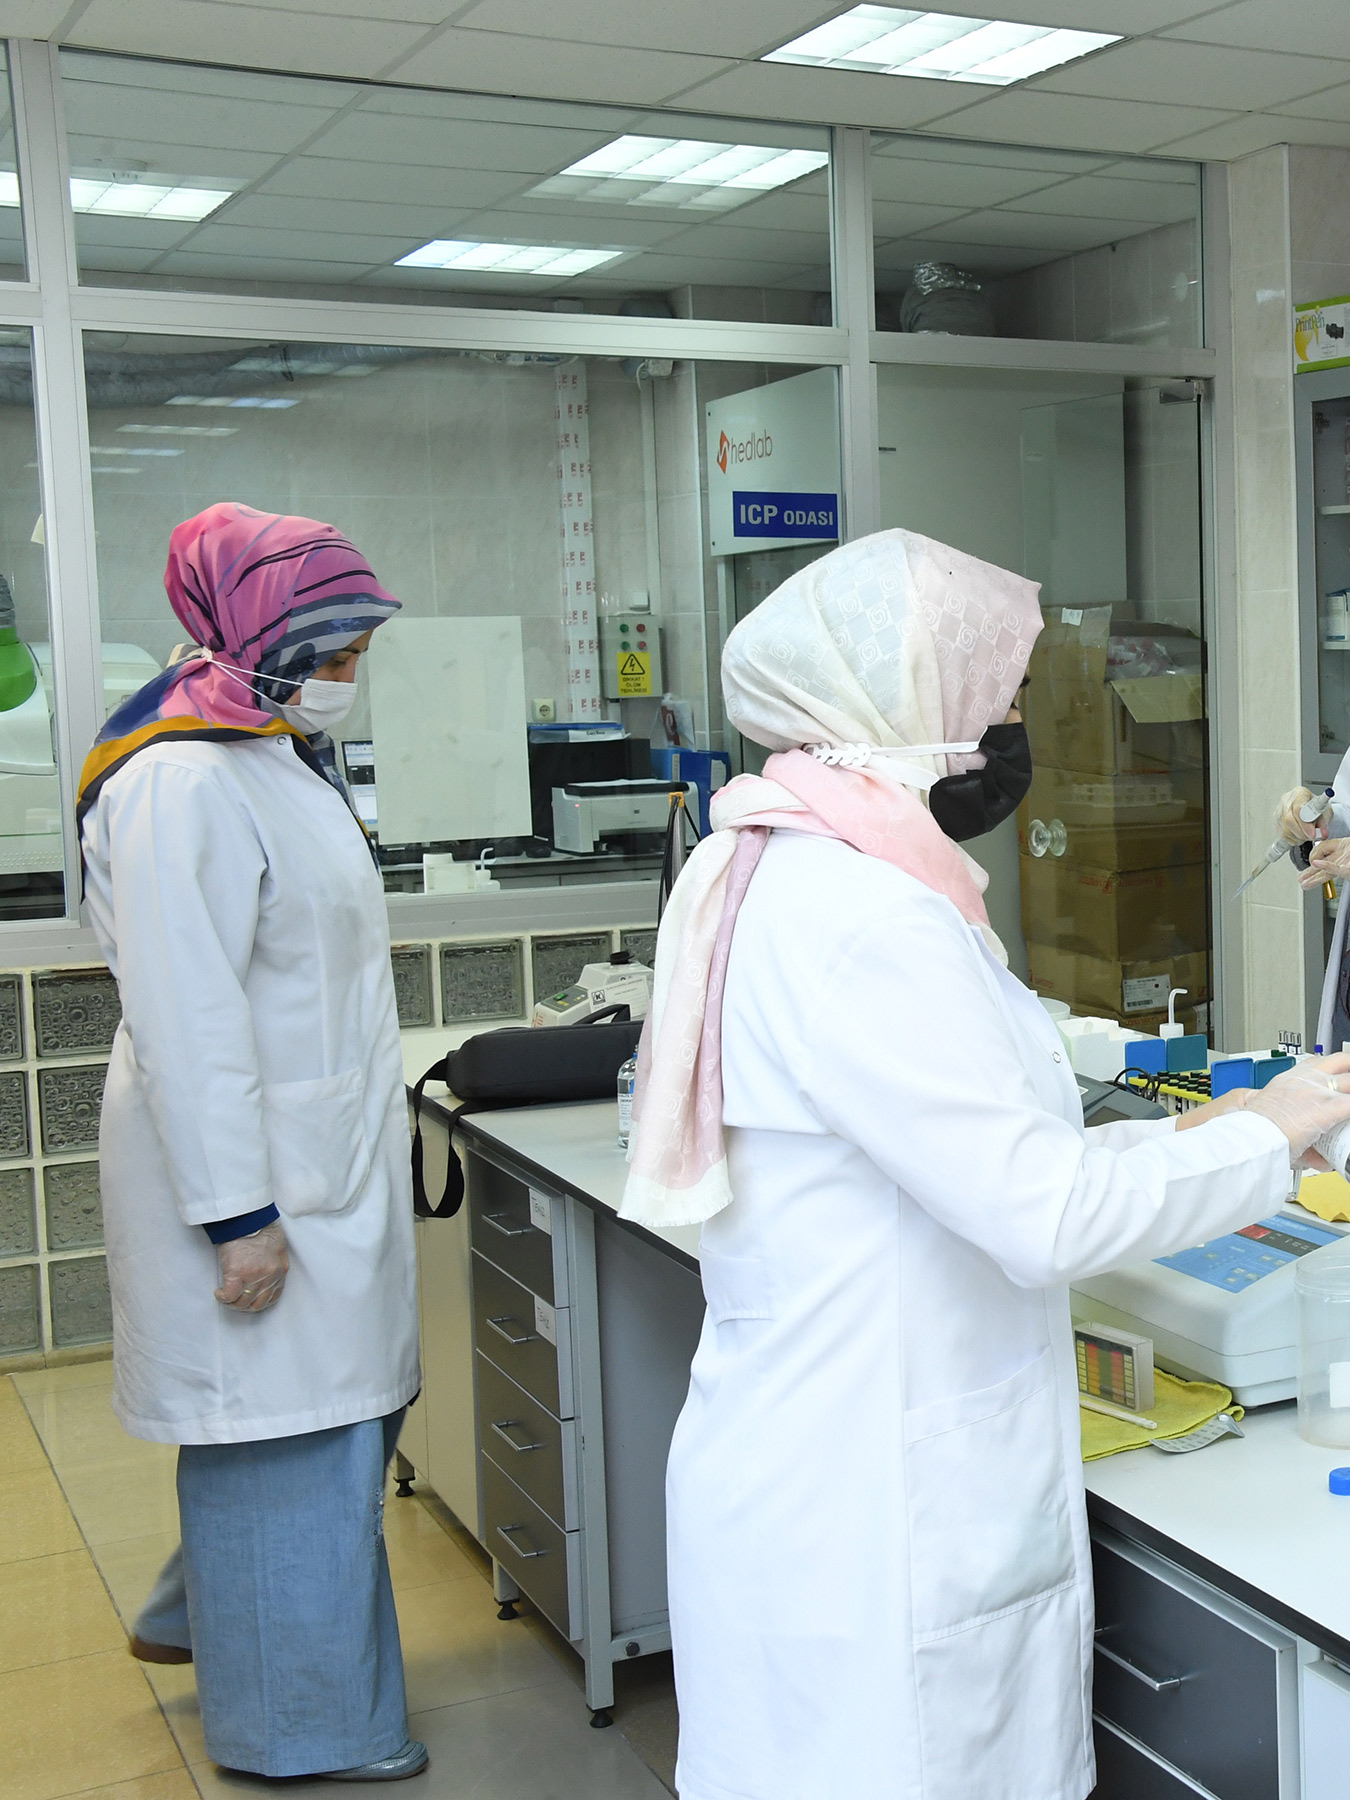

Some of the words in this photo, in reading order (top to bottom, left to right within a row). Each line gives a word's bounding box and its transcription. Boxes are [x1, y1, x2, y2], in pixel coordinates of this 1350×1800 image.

[731, 429, 773, 464] hedlab
[740, 504, 778, 525] ICP
[783, 510, 834, 526] ODASI
